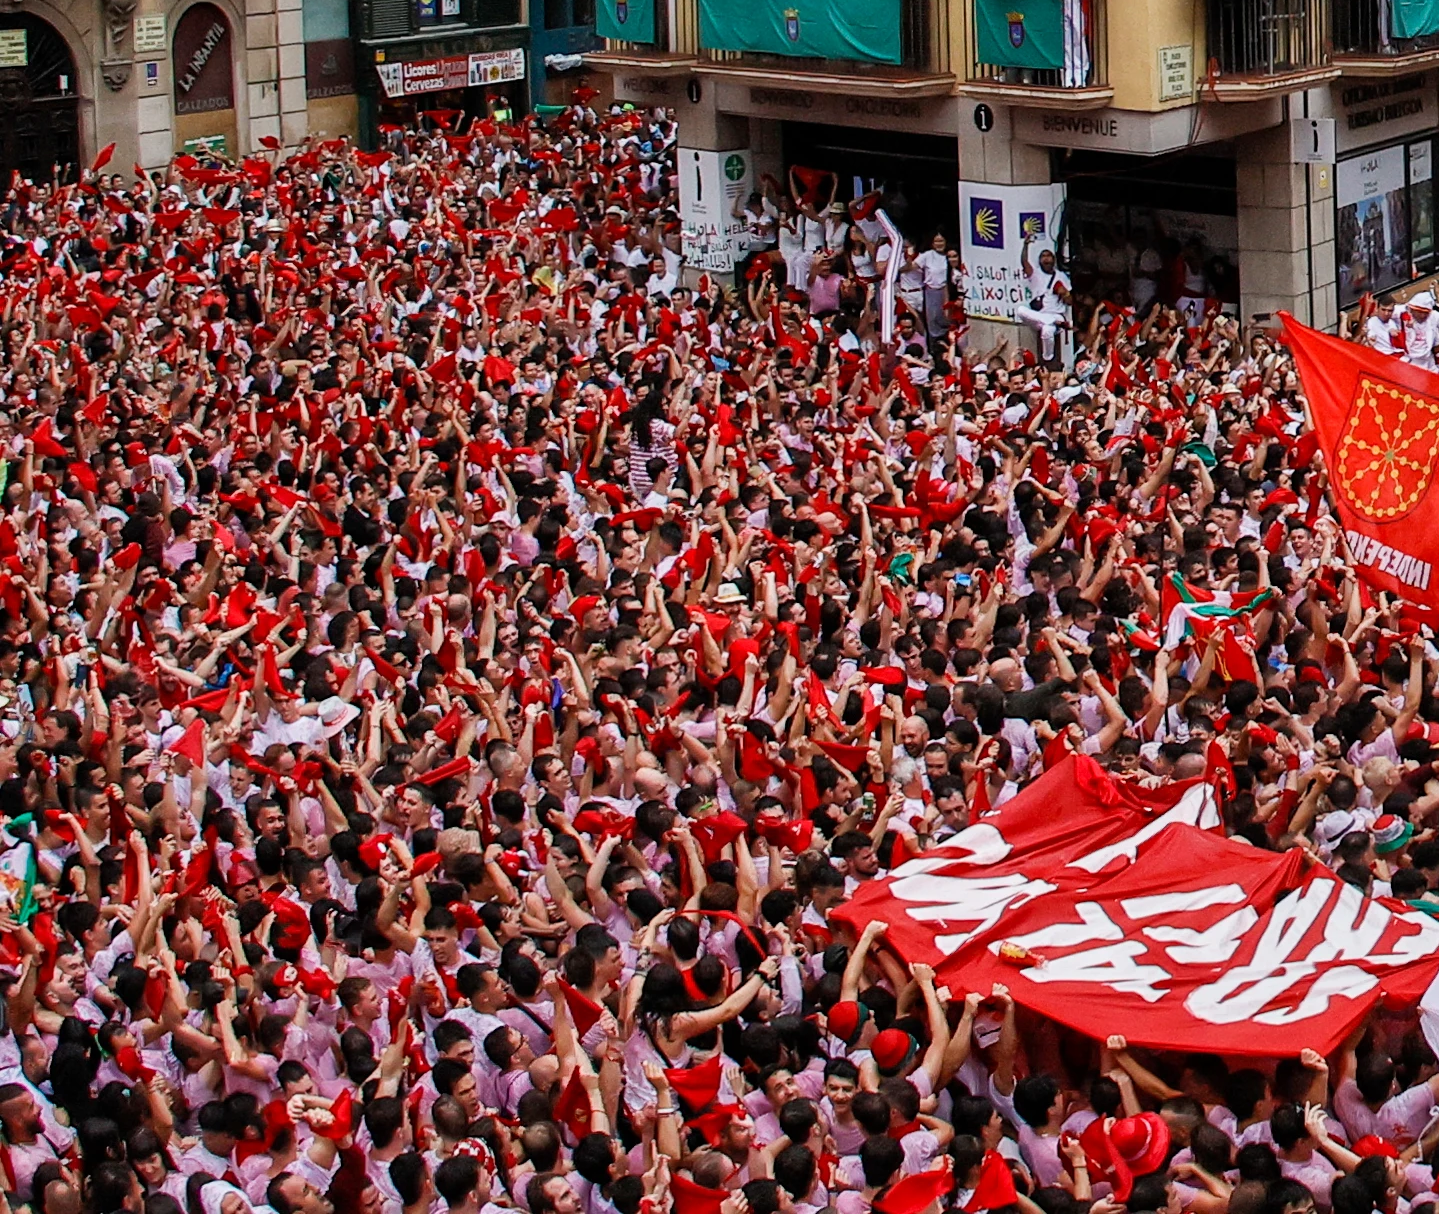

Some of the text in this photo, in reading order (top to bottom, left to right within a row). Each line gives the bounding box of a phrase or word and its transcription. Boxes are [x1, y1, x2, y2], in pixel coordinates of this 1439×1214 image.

[404, 63, 437, 78] Licores
[178, 75, 195, 92] LA
[404, 76, 444, 92] Cervezas
[178, 97, 229, 112] CALZADOS
[1043, 115, 1118, 137] BIENVENUE
